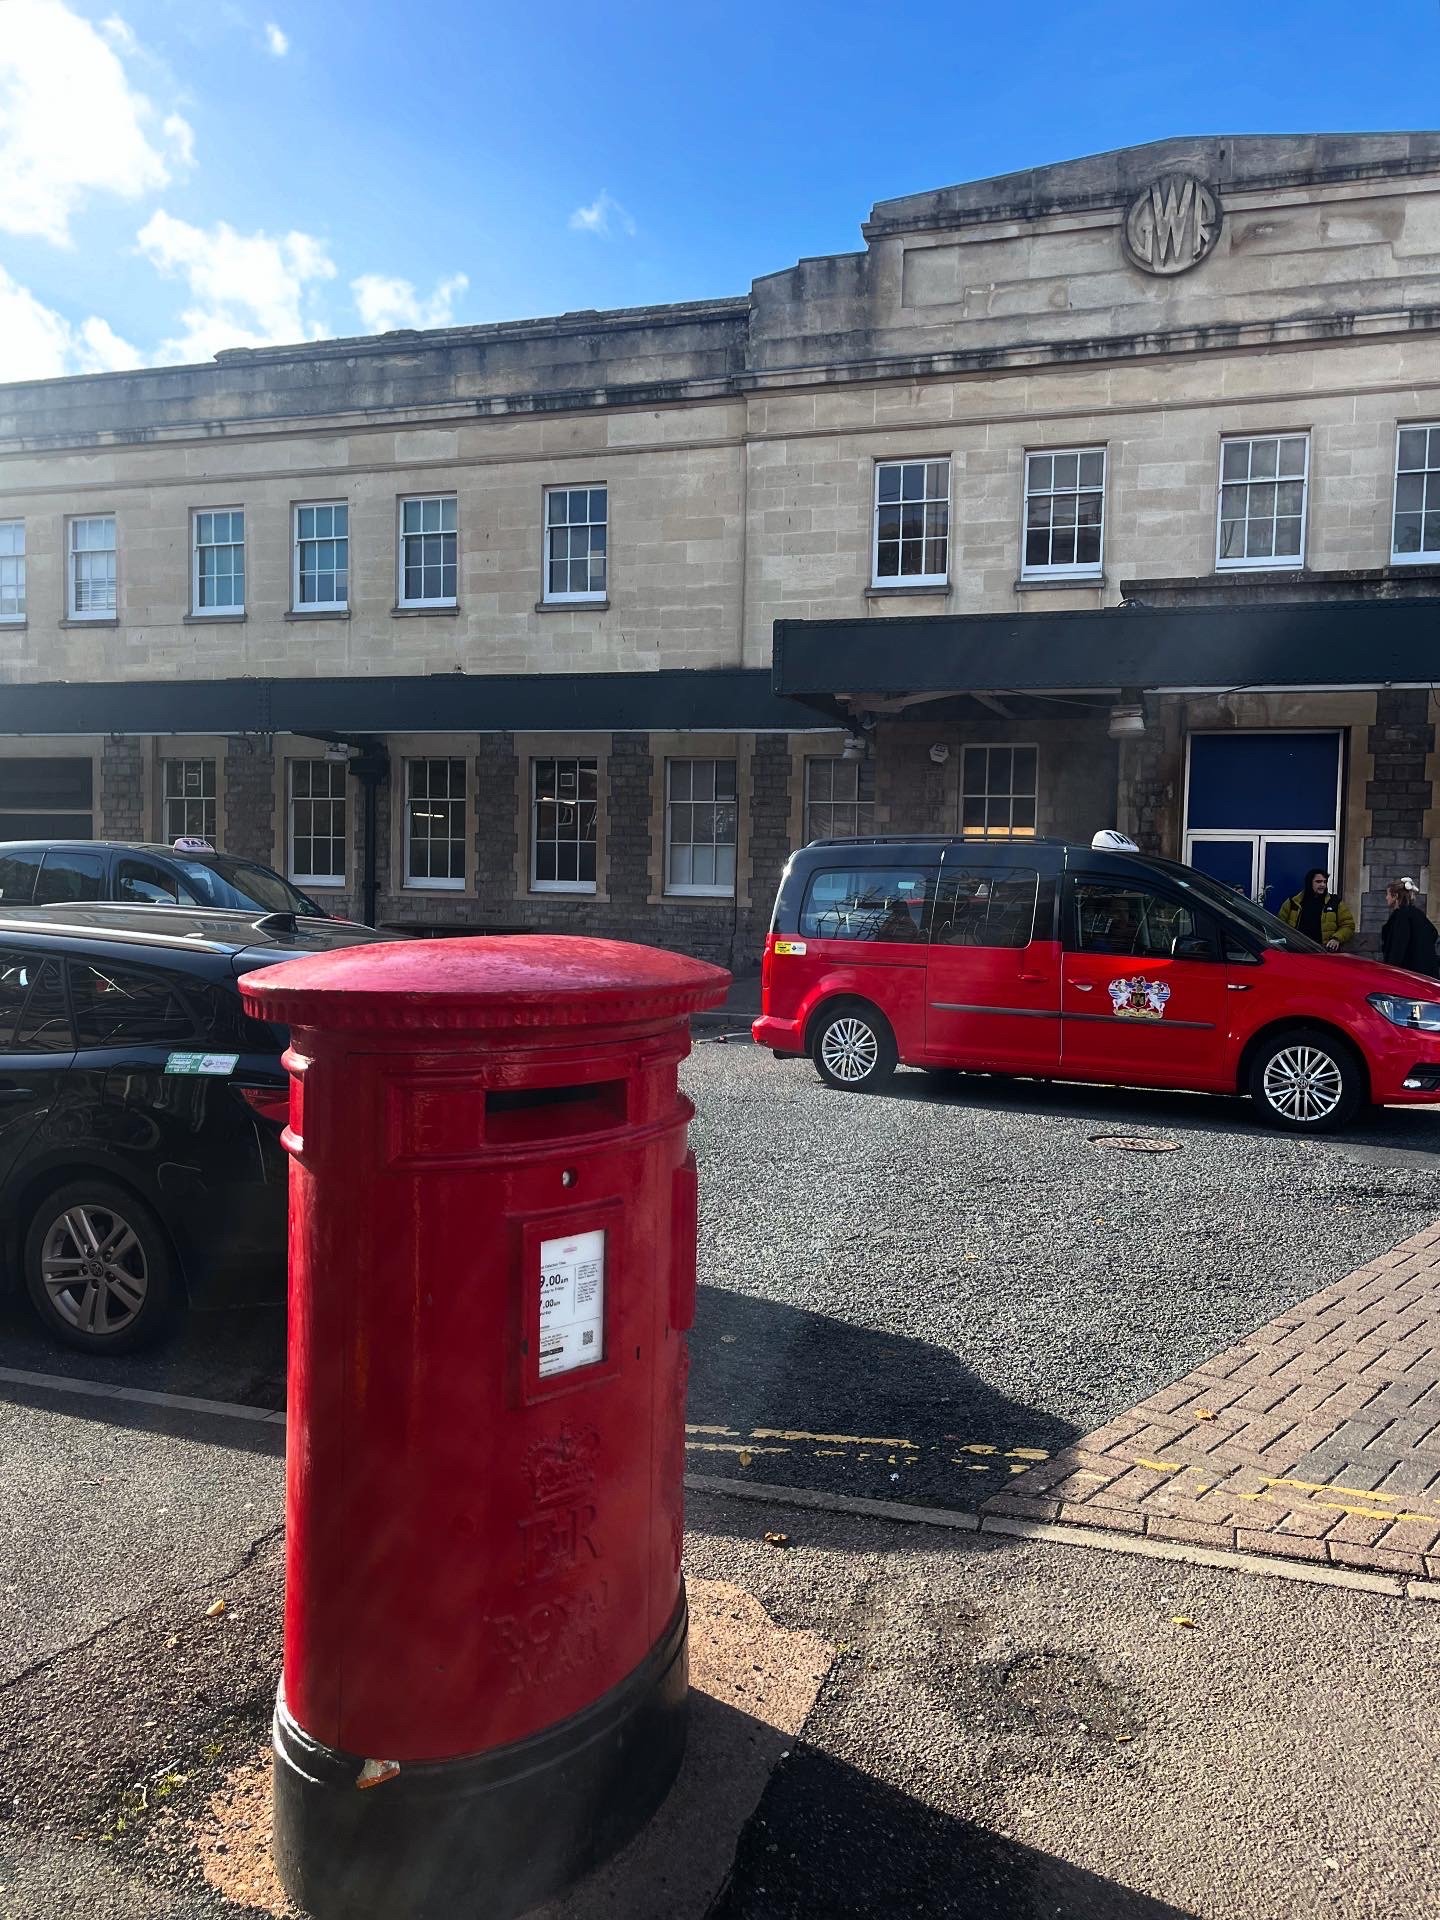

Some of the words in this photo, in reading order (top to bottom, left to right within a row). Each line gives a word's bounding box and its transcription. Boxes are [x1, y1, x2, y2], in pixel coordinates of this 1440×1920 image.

[1129, 178, 1217, 264] GWR
[182, 840, 212, 848] TAXI
[483, 1578, 609, 1654] ROYAL
